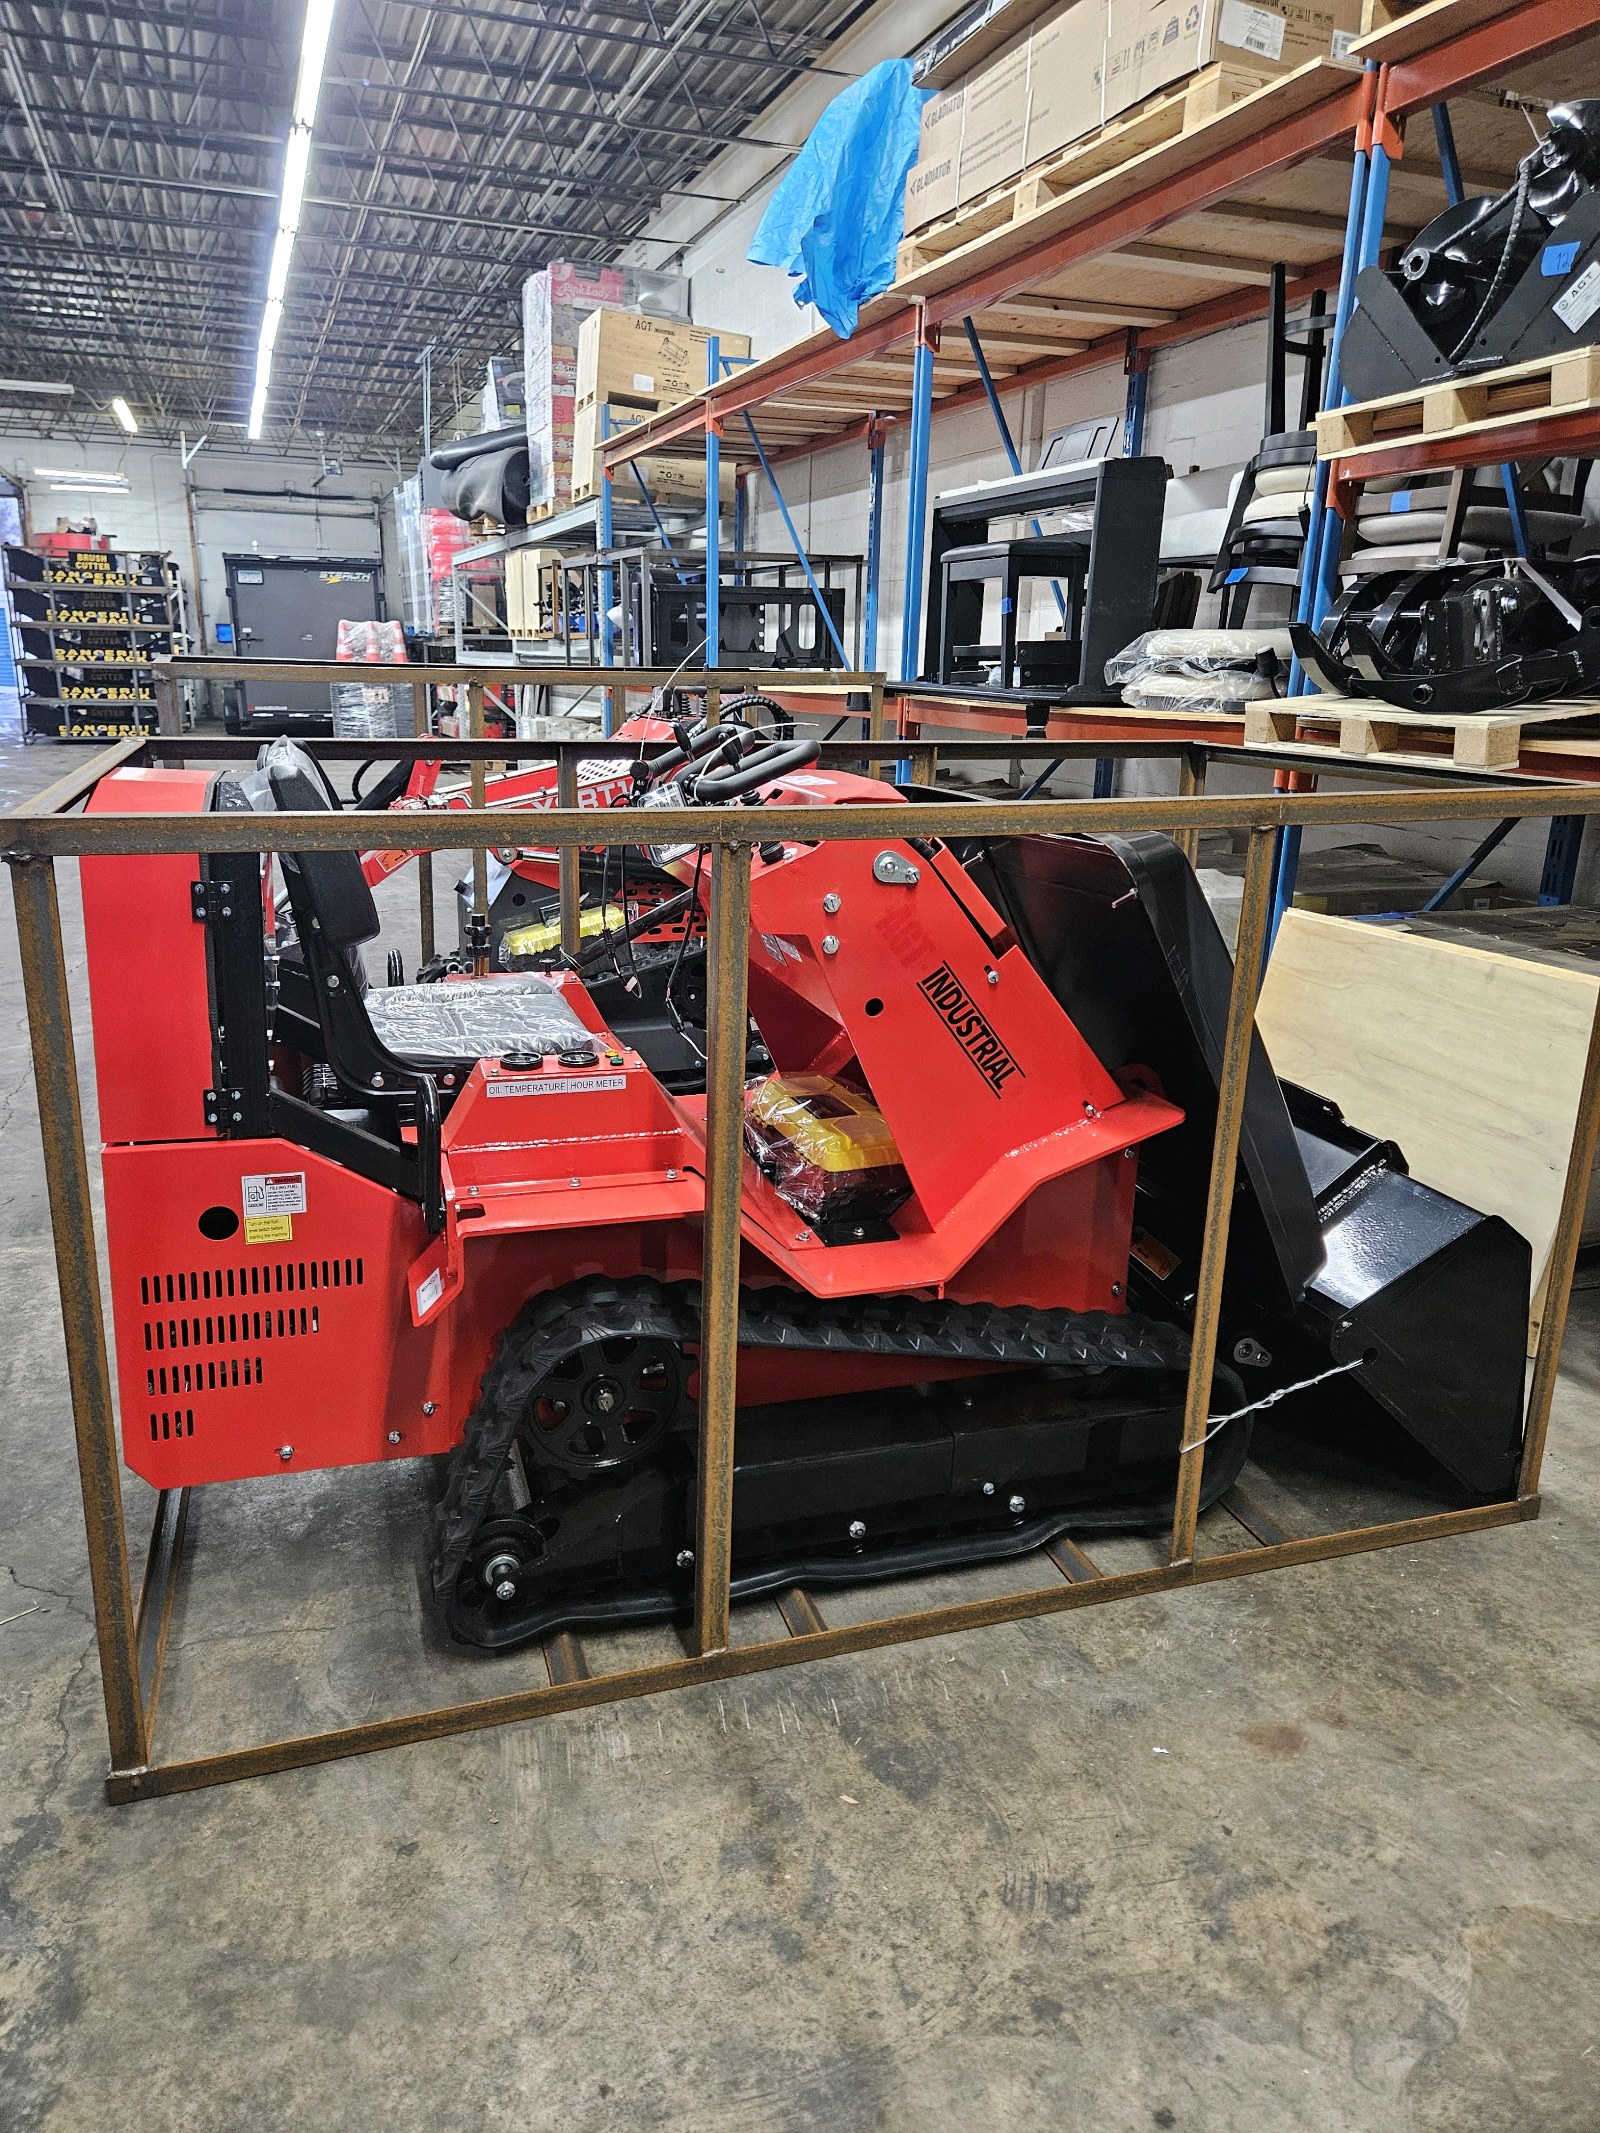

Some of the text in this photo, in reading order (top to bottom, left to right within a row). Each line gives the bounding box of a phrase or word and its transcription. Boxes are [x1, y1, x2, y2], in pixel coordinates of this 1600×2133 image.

[916, 159, 951, 193] GLADIATOR
[1556, 252, 1570, 270] 12
[564, 283, 610, 300] Pink Lady
[1571, 271, 1592, 298] AGT
[635, 320, 652, 331] AGT
[77, 553, 107, 562] BRUSH
[75, 562, 110, 570] CUTTER
[319, 571, 371, 582] STEALTH
[921, 966, 1016, 1090] INDUSTRIAL
[489, 1079, 623, 1094] OIL TEMPERATURE HOUR METER
